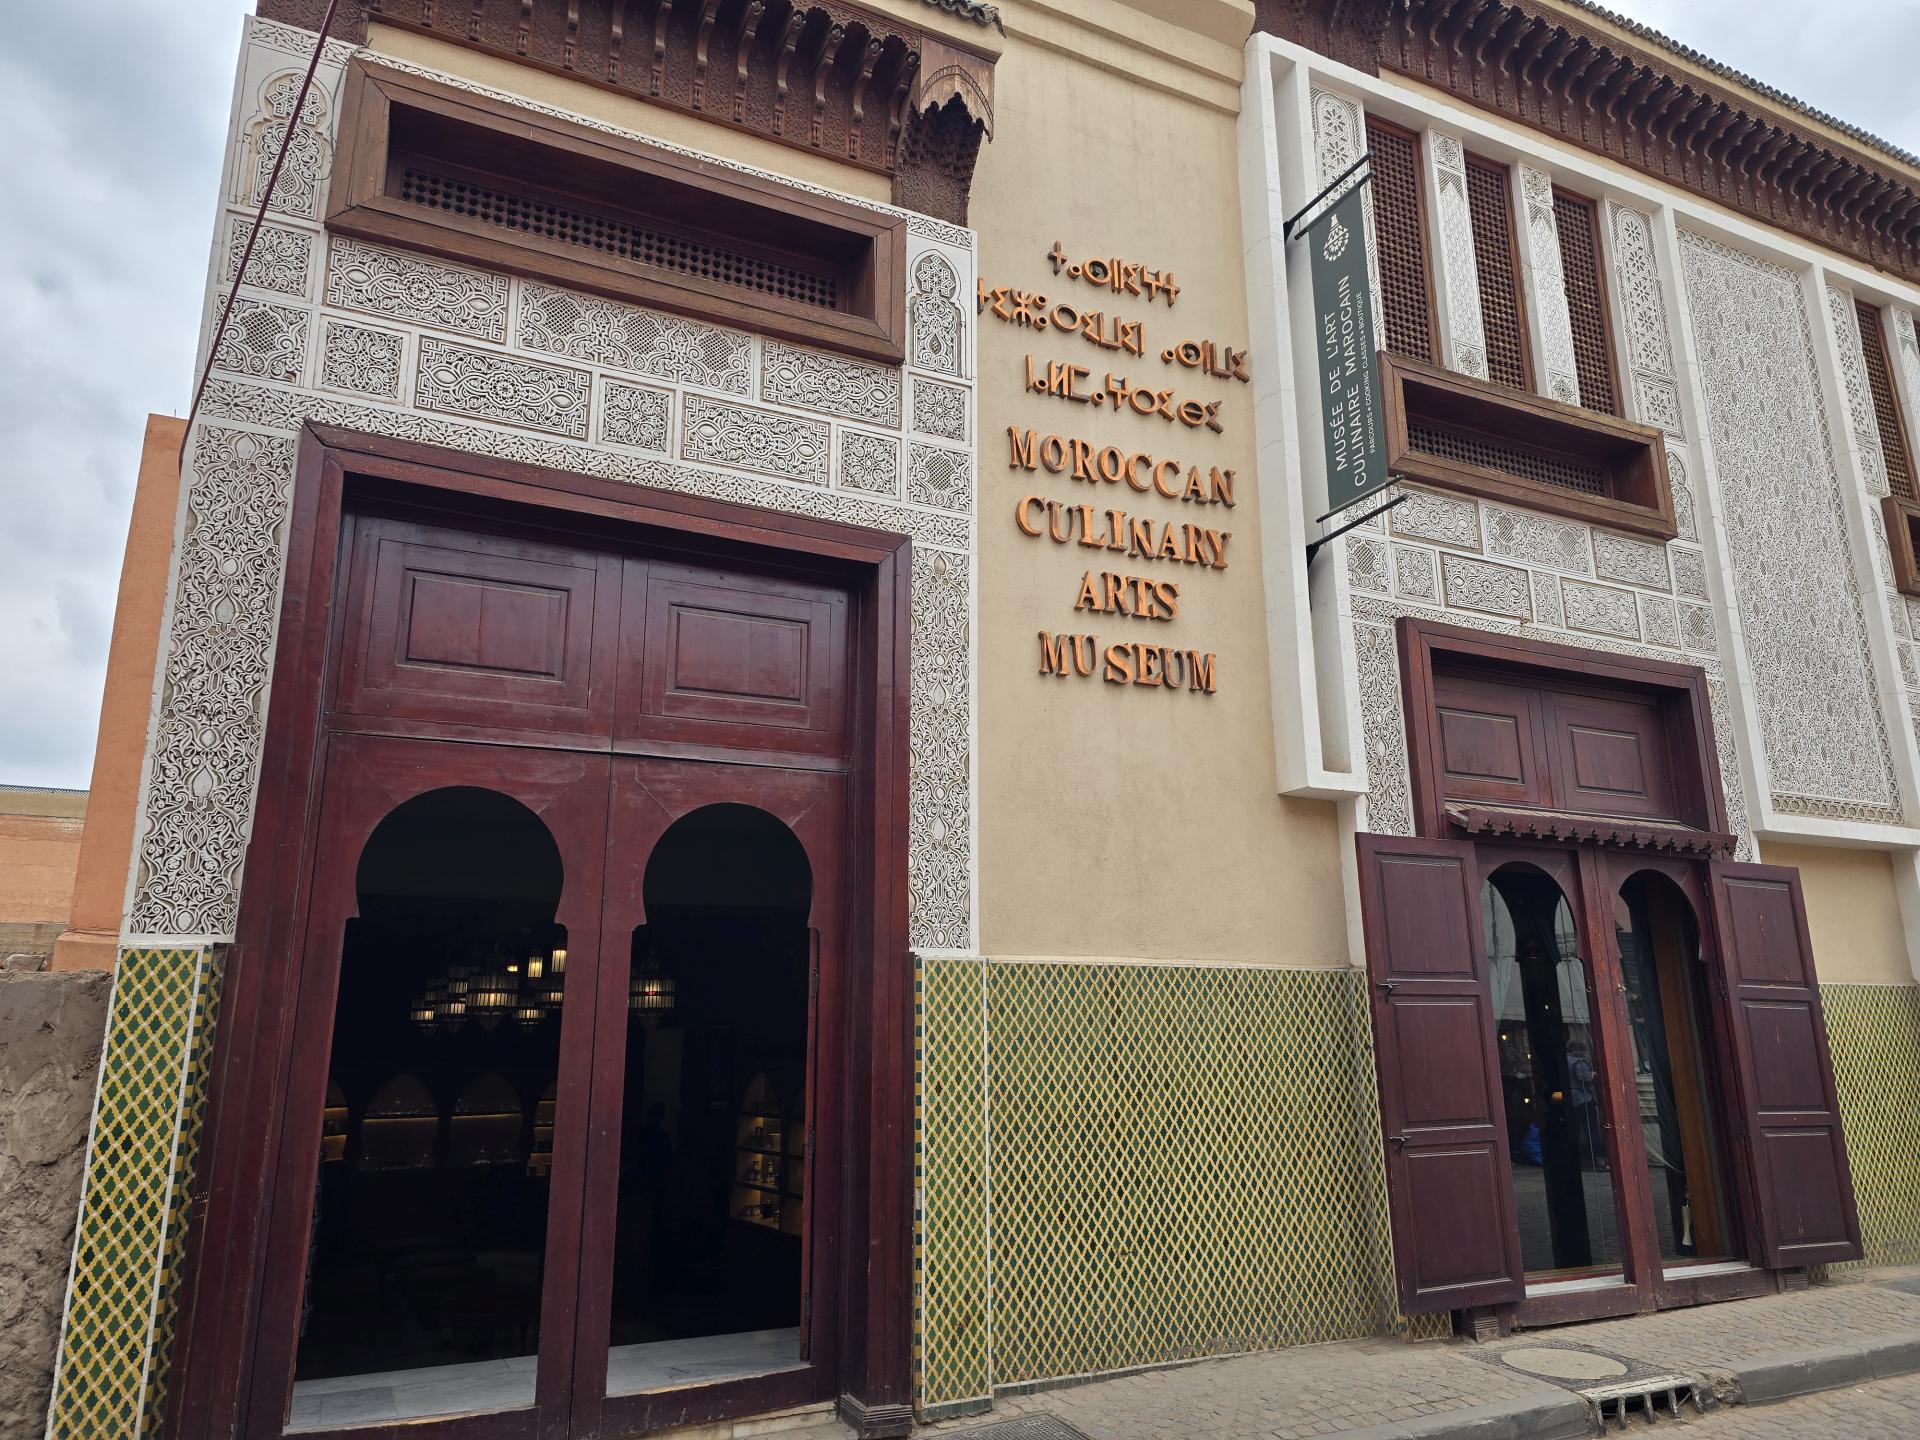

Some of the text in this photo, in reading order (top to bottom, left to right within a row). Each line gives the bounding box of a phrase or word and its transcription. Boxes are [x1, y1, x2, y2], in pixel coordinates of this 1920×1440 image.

[1324, 312, 1348, 472] MUSÉE DE L'ART
[1338, 275, 1367, 487] CULINAIRE MAROCAIN
[1356, 290, 1376, 453] PARCOURS COOKING CLASSES BOUTIQUE
[1007, 425, 1237, 509] MOROCCAN
[1015, 494, 1232, 570] CULINARY
[1073, 570, 1181, 622] ARTS
[1038, 630, 1217, 695] MUSEUM
